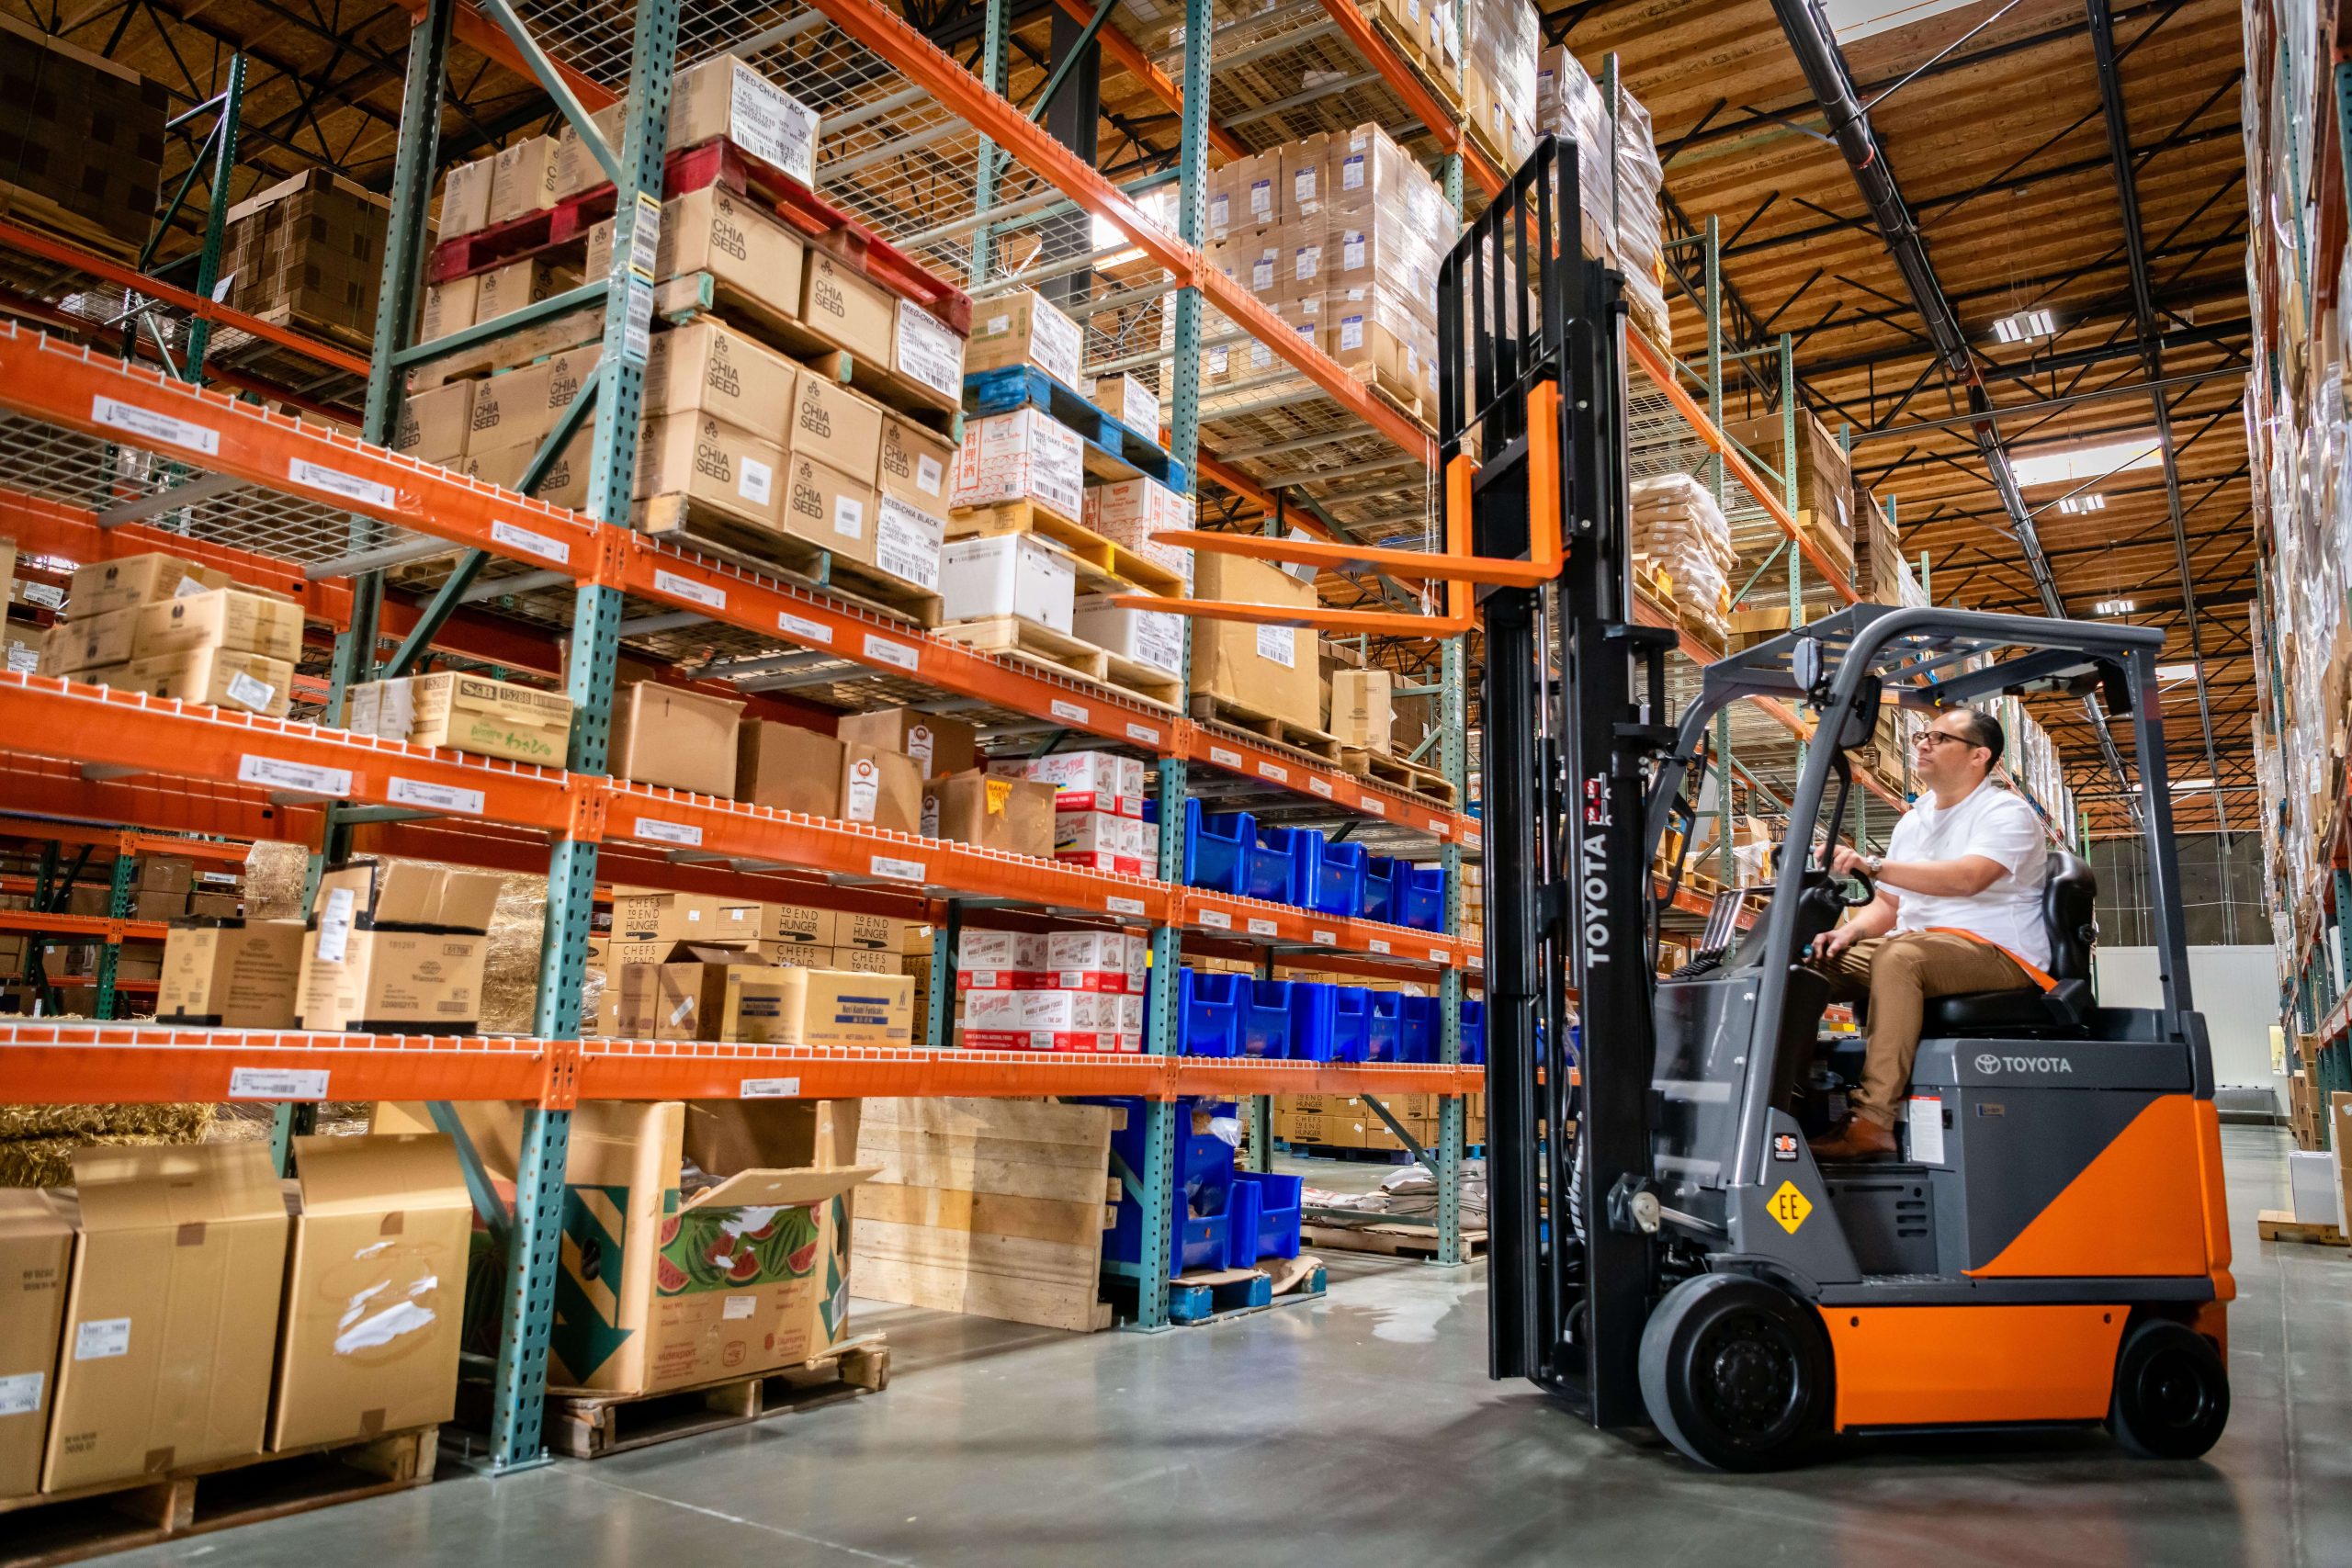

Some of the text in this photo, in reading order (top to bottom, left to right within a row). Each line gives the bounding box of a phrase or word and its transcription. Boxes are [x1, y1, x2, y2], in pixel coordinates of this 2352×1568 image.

[736, 68, 777, 100] SEED-CHIA
[780, 97, 807, 118] BLACK
[712, 219, 745, 247] CHIA
[711, 232, 747, 262] SEED
[816, 279, 843, 305] CHIA
[814, 293, 845, 318] SEED
[709, 358, 739, 383] CHIA
[550, 378, 578, 395] CHIA
[707, 372, 741, 398] SEED
[474, 401, 499, 418] CHIA
[802, 401, 830, 424] CHIA
[472, 414, 500, 432] SEED
[800, 415, 831, 439] SEED
[697, 444, 729, 468] CHIA
[884, 444, 908, 466] CHIA
[551, 460, 569, 476] HIA
[696, 459, 731, 483] SEED
[883, 457, 910, 479] SEED
[540, 474, 571, 492] SEED
[794, 484, 822, 505] CHIA
[793, 498, 823, 520] SEED
[884, 497, 938, 528] SEED-CHIA BLACK
[502, 689, 531, 704] 15288
[628, 898, 661, 908] CHEFS
[1584, 834, 1610, 968] TOYOTA
[639, 909, 660, 919] END
[782, 907, 819, 920] TO END
[855, 915, 888, 929] TO END
[626, 920, 659, 931] HUNGER
[779, 919, 818, 932] HUNGER
[854, 927, 888, 940] HUNGER
[623, 946, 656, 955] CHEFS
[776, 945, 815, 957] CHEFS
[993, 941, 1006, 951] FOODS
[852, 952, 886, 964] CHEFS
[902, 957, 926, 966] HEFS
[864, 965, 886, 974] END
[1051, 1000, 1063, 1009] FOODS
[2003, 1057, 2072, 1073] TOYOTA
[1775, 1135, 1797, 1151] SAS
[1780, 1195, 1799, 1220] EE
